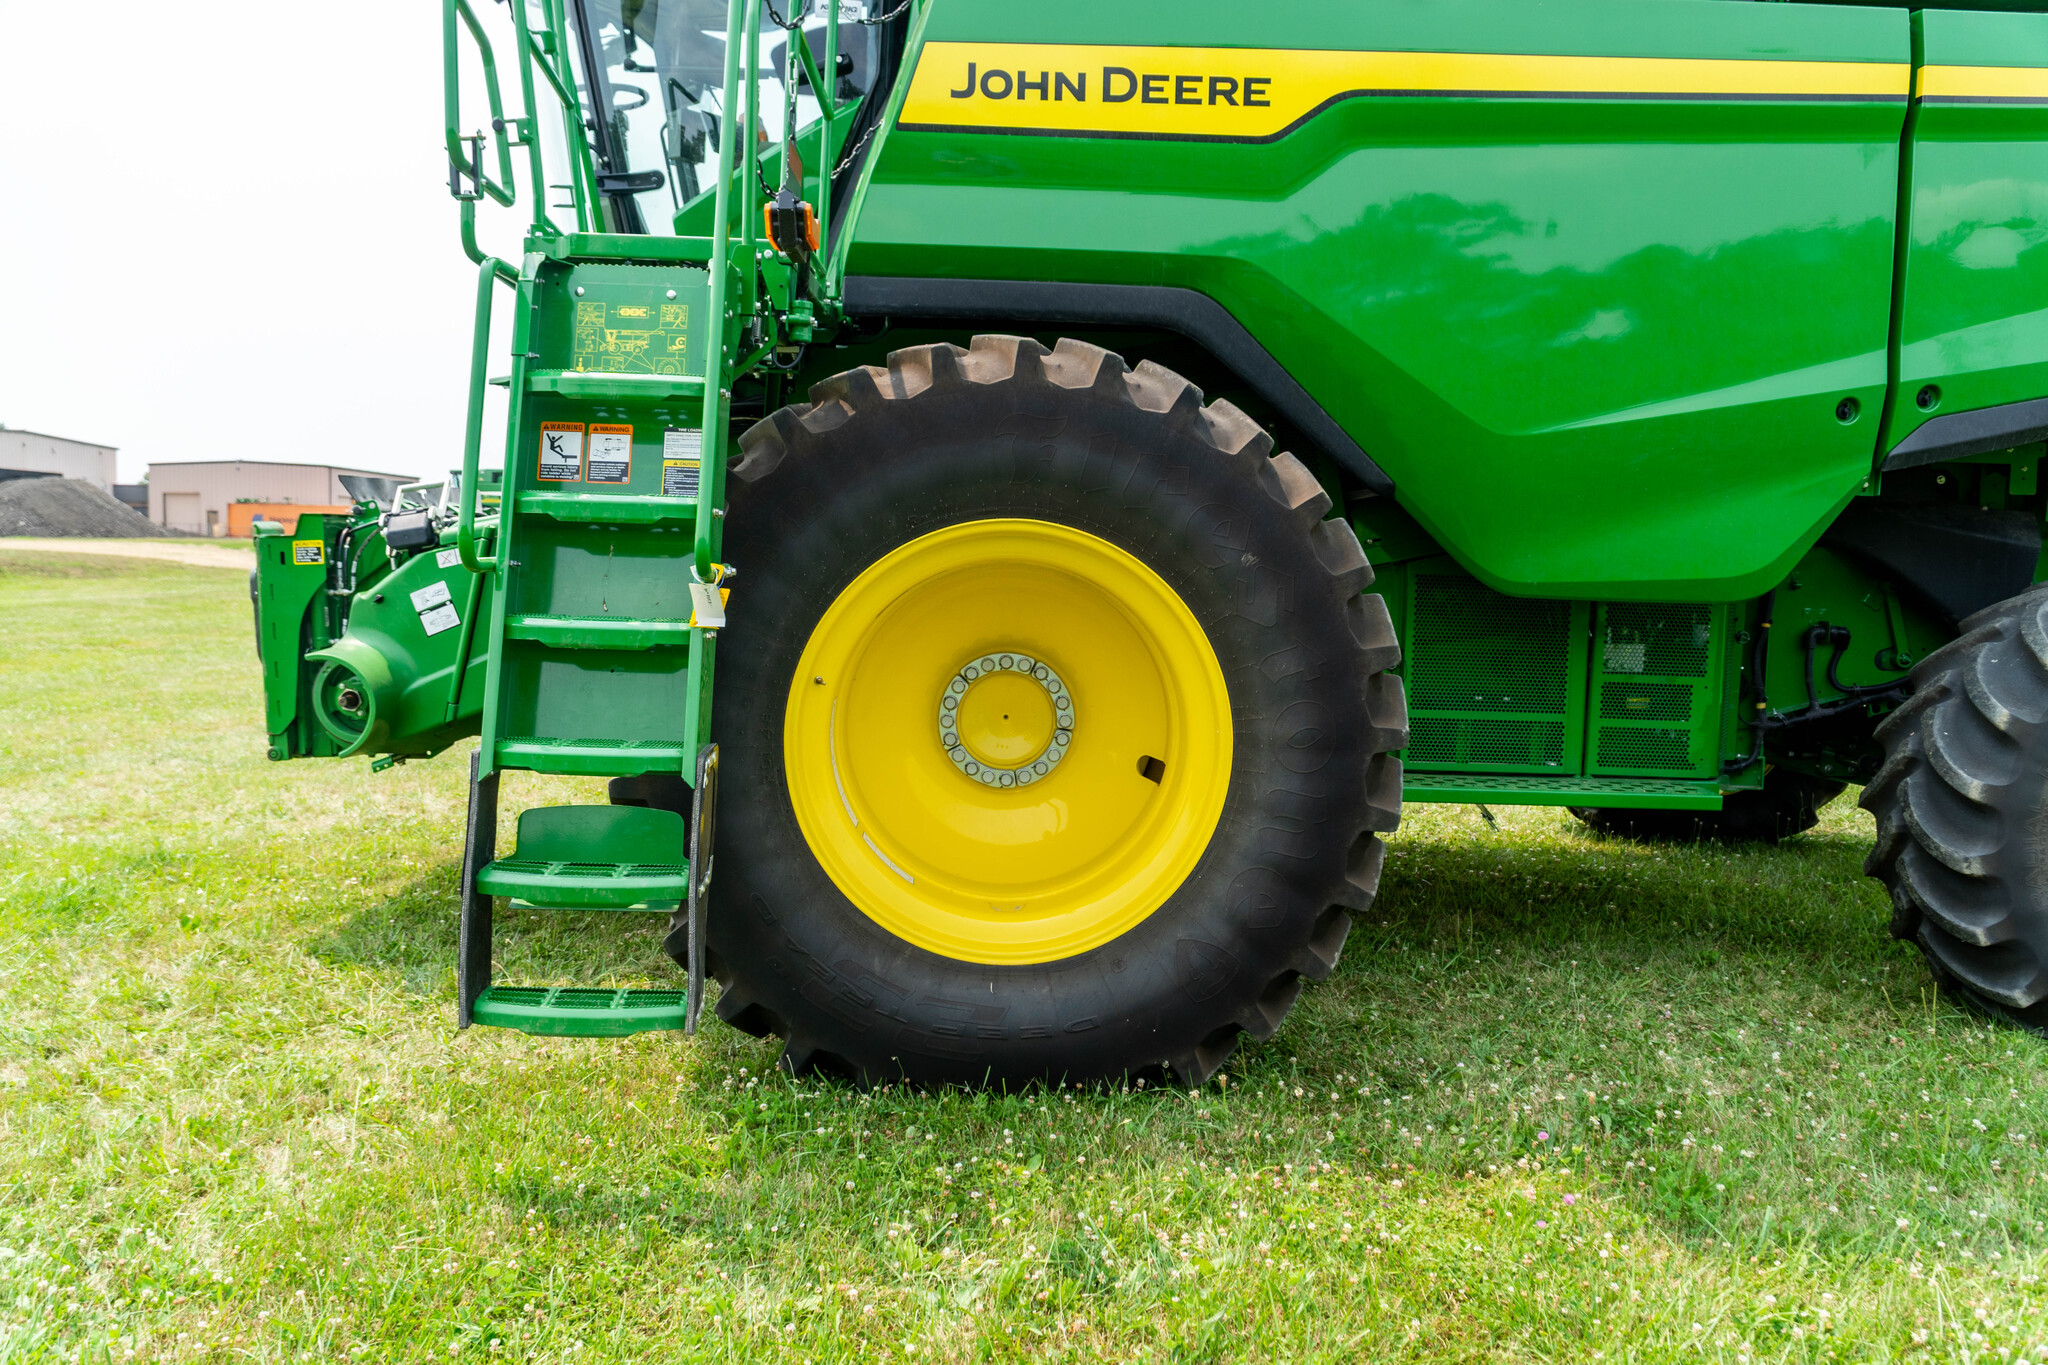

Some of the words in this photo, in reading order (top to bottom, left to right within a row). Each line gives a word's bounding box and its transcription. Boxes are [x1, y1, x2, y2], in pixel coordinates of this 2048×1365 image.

[950, 62, 1087, 102] JOHN
[1102, 66, 1272, 107] DEERE
[550, 423, 583, 431] WARNING
